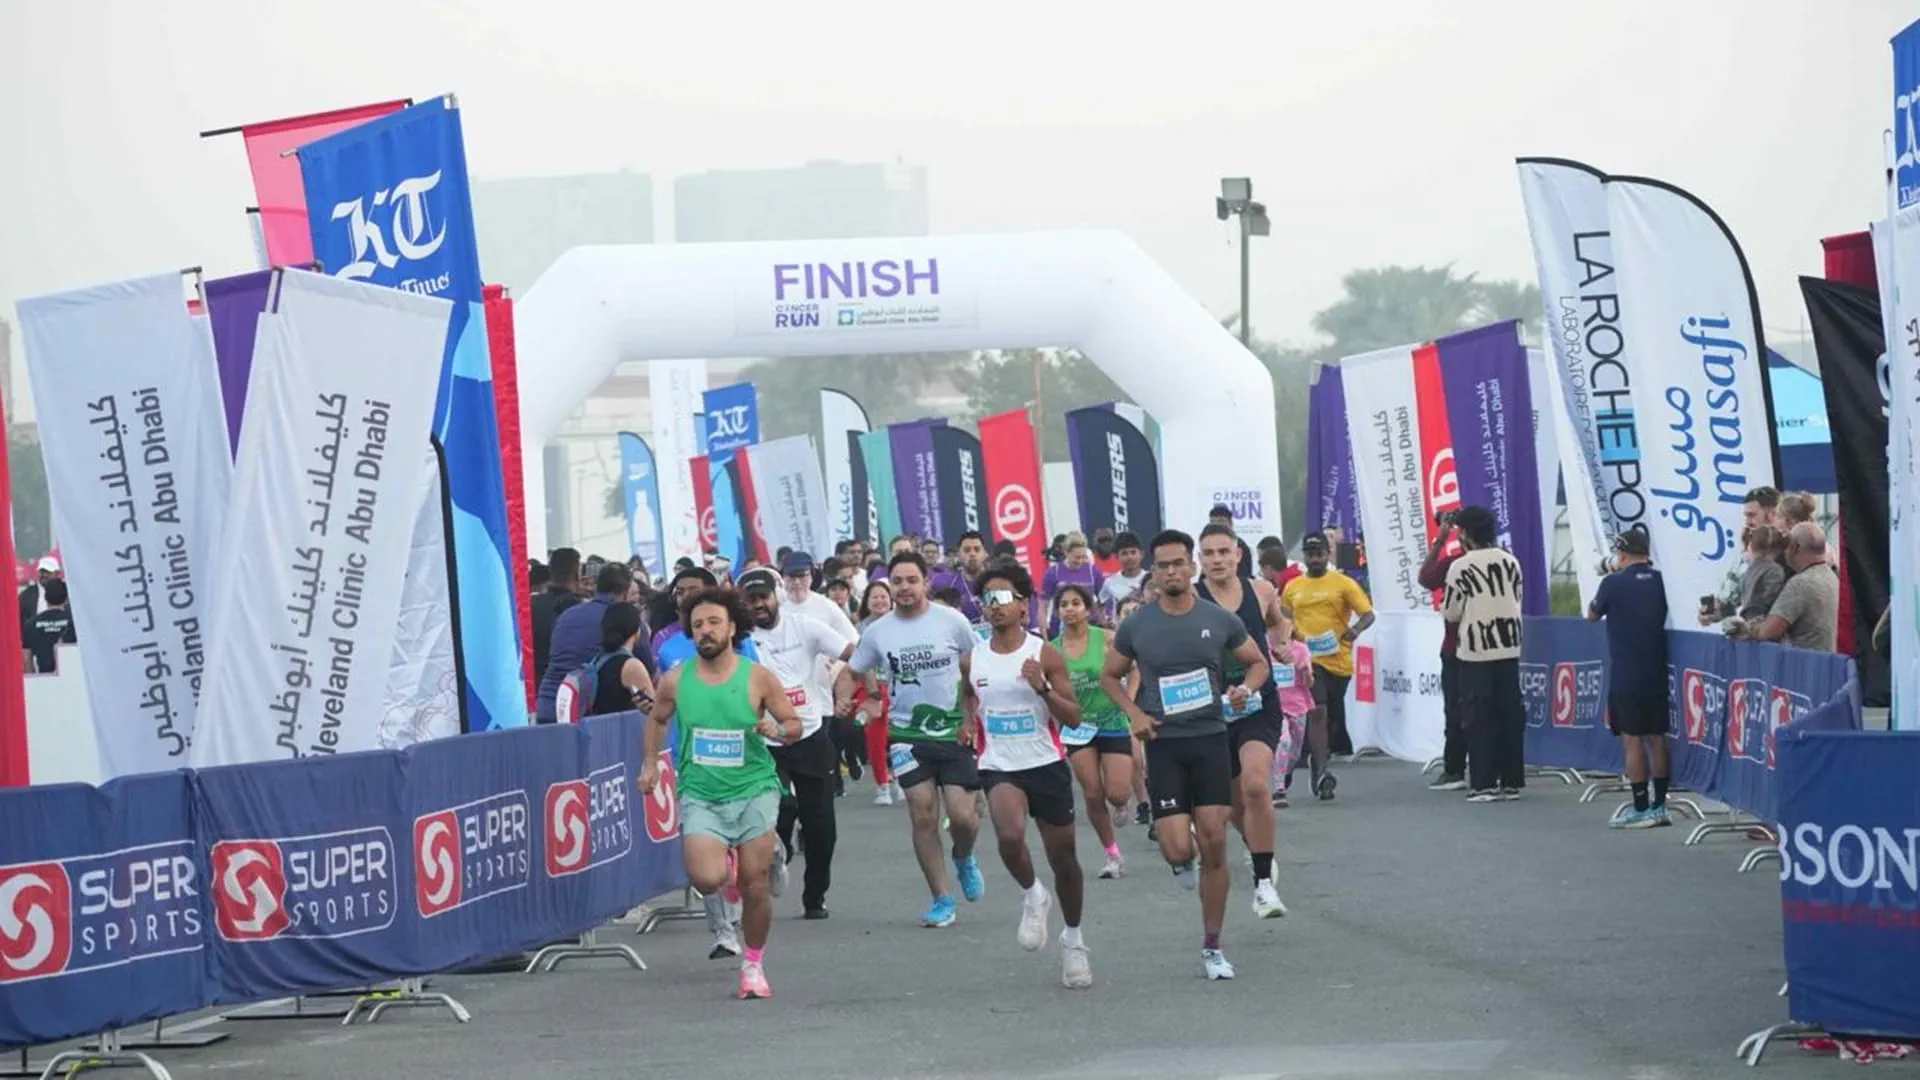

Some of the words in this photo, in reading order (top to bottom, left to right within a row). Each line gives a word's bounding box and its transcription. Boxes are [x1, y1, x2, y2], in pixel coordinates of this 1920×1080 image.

[774, 258, 939, 301] FINISH
[1573, 231, 1615, 289] LA
[775, 312, 820, 328] RUN
[1580, 294, 1638, 450] ROCHE
[132, 387, 170, 466] Dhabi
[353, 399, 392, 481] Dhabi
[1395, 405, 1413, 450] Dhabi
[1680, 316, 1748, 504] masafi
[87, 395, 138, 533] كليفلاند
[151, 471, 181, 524] Abu
[307, 393, 349, 537] كليفلاند
[958, 448, 980, 533] CHERS
[1403, 453, 1417, 481] Abu
[1650, 386, 1735, 562] مسافي
[344, 488, 377, 545] Abu
[1406, 486, 1425, 529] Clinic
[114, 544, 155, 632] كلينك
[160, 533, 195, 610] Clinic
[287, 546, 326, 638] كلينك
[331, 552, 368, 629] Clinic
[900, 651, 932, 663] ROAD
[902, 657, 951, 673] RUNNERS
[121, 641, 192, 757] أبوظبي
[310, 637, 354, 755] leveland
[464, 803, 527, 856] SUPER
[80, 855, 199, 915] SUPER
[289, 841, 388, 892] SUPER
[290, 889, 389, 928] SPORTS
